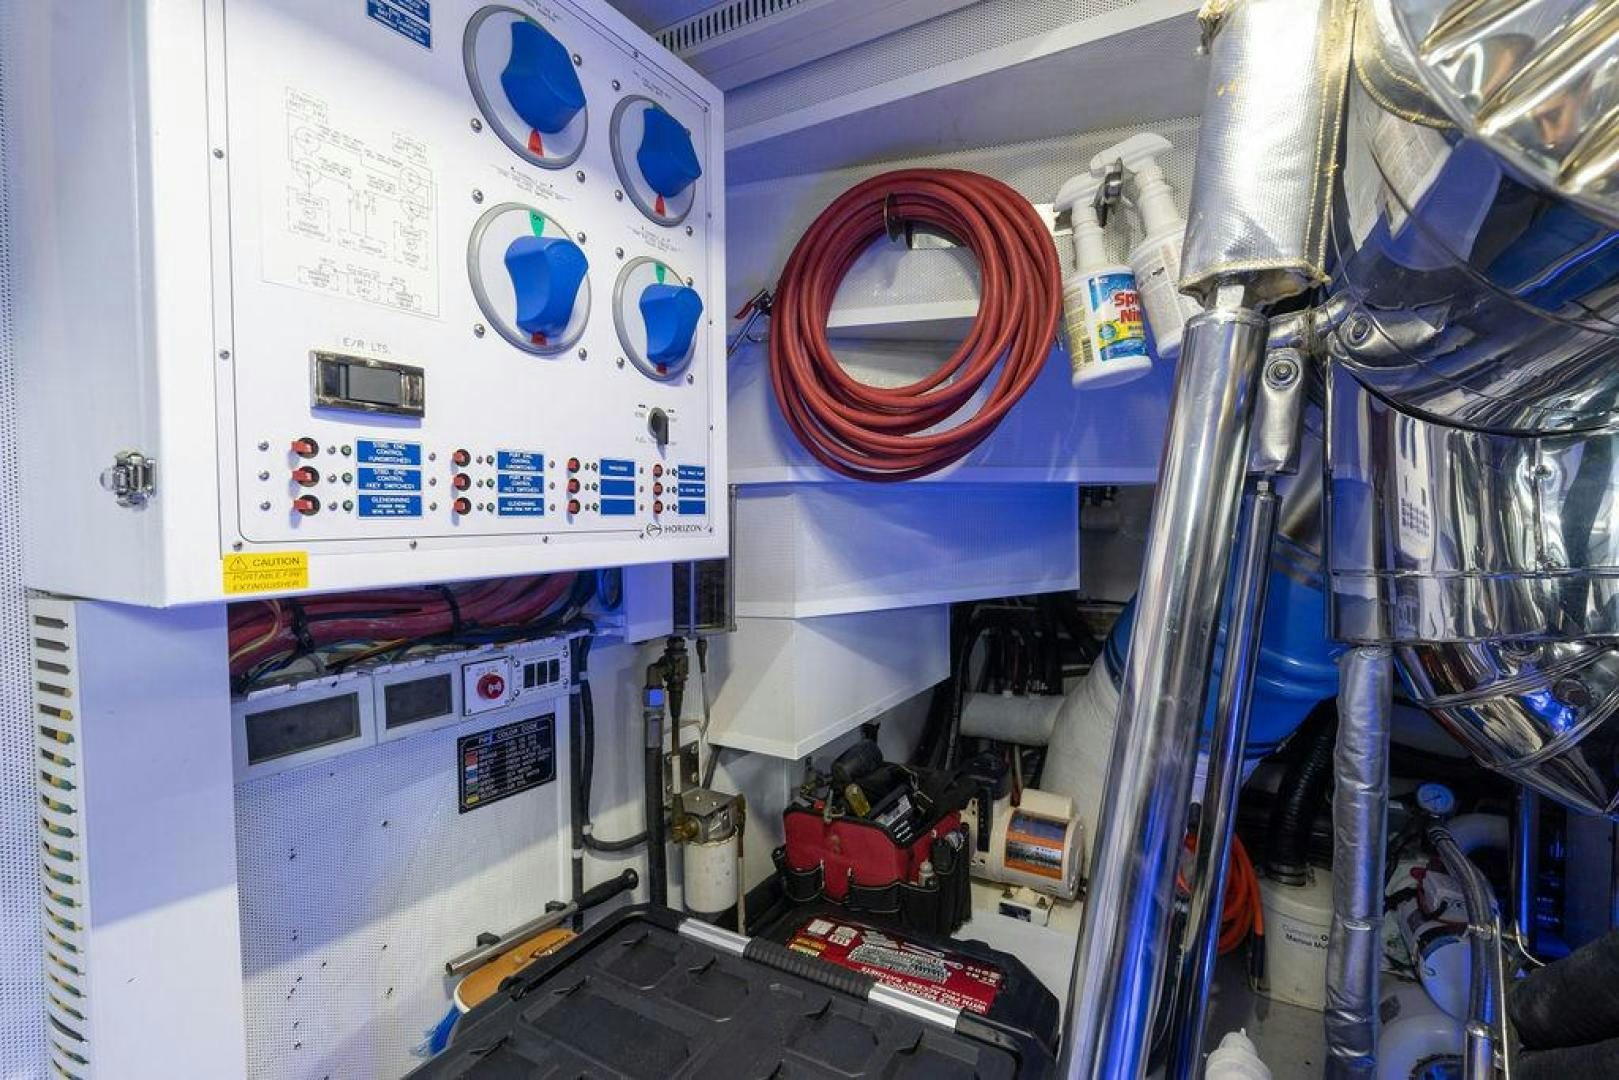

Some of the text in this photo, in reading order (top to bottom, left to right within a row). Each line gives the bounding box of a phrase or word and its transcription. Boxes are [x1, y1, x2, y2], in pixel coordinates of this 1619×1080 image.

[343, 337, 365, 349] E/R
[663, 524, 702, 533] HORIZON
[253, 556, 300, 567] CAUTION
